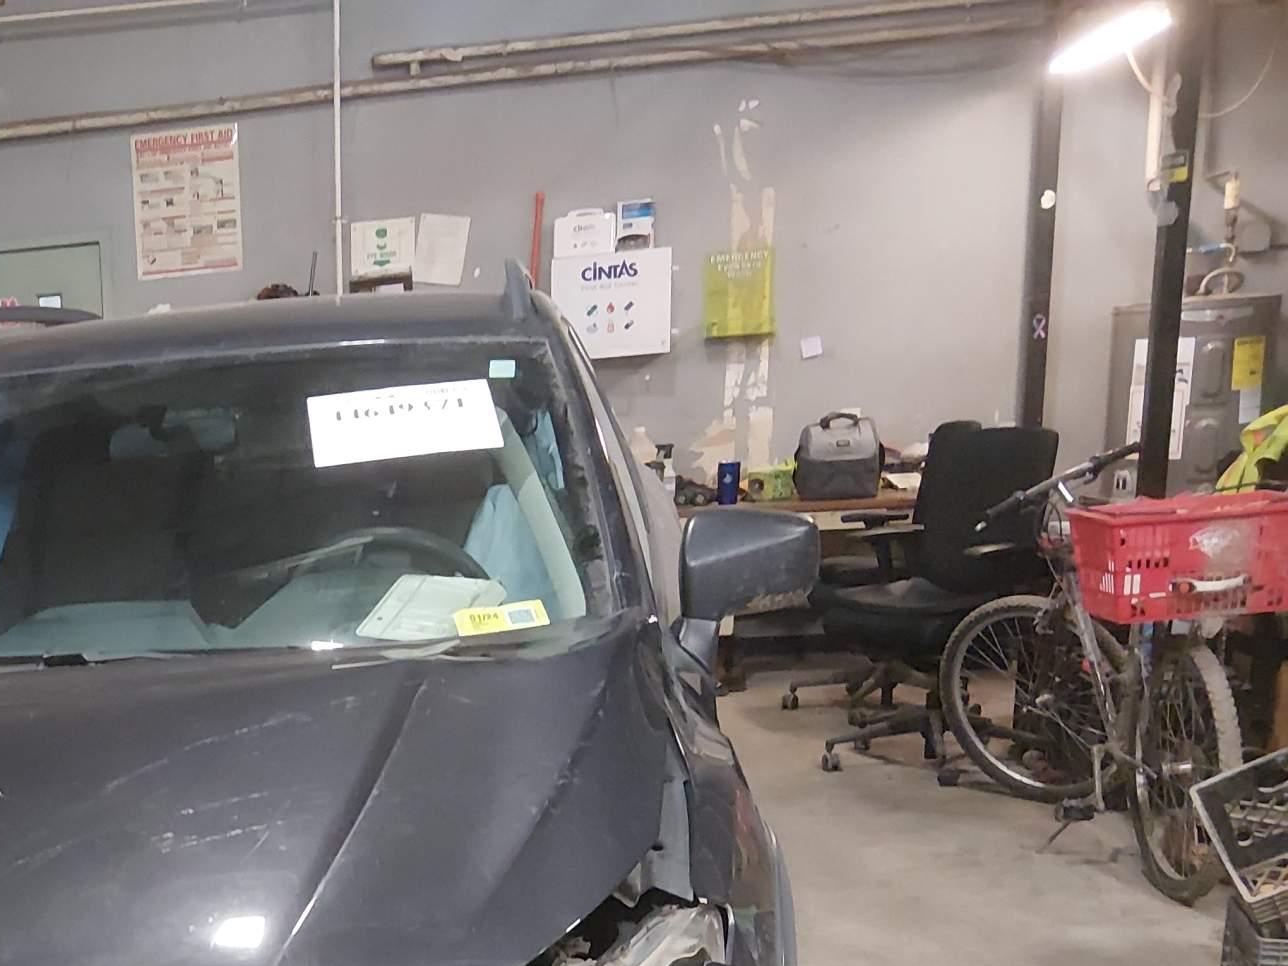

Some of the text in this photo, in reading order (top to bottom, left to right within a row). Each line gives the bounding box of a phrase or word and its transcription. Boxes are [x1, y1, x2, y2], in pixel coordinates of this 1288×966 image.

[134, 127, 233, 151] EMERGENCY FIRST AID
[580, 259, 639, 282] CINTAS
